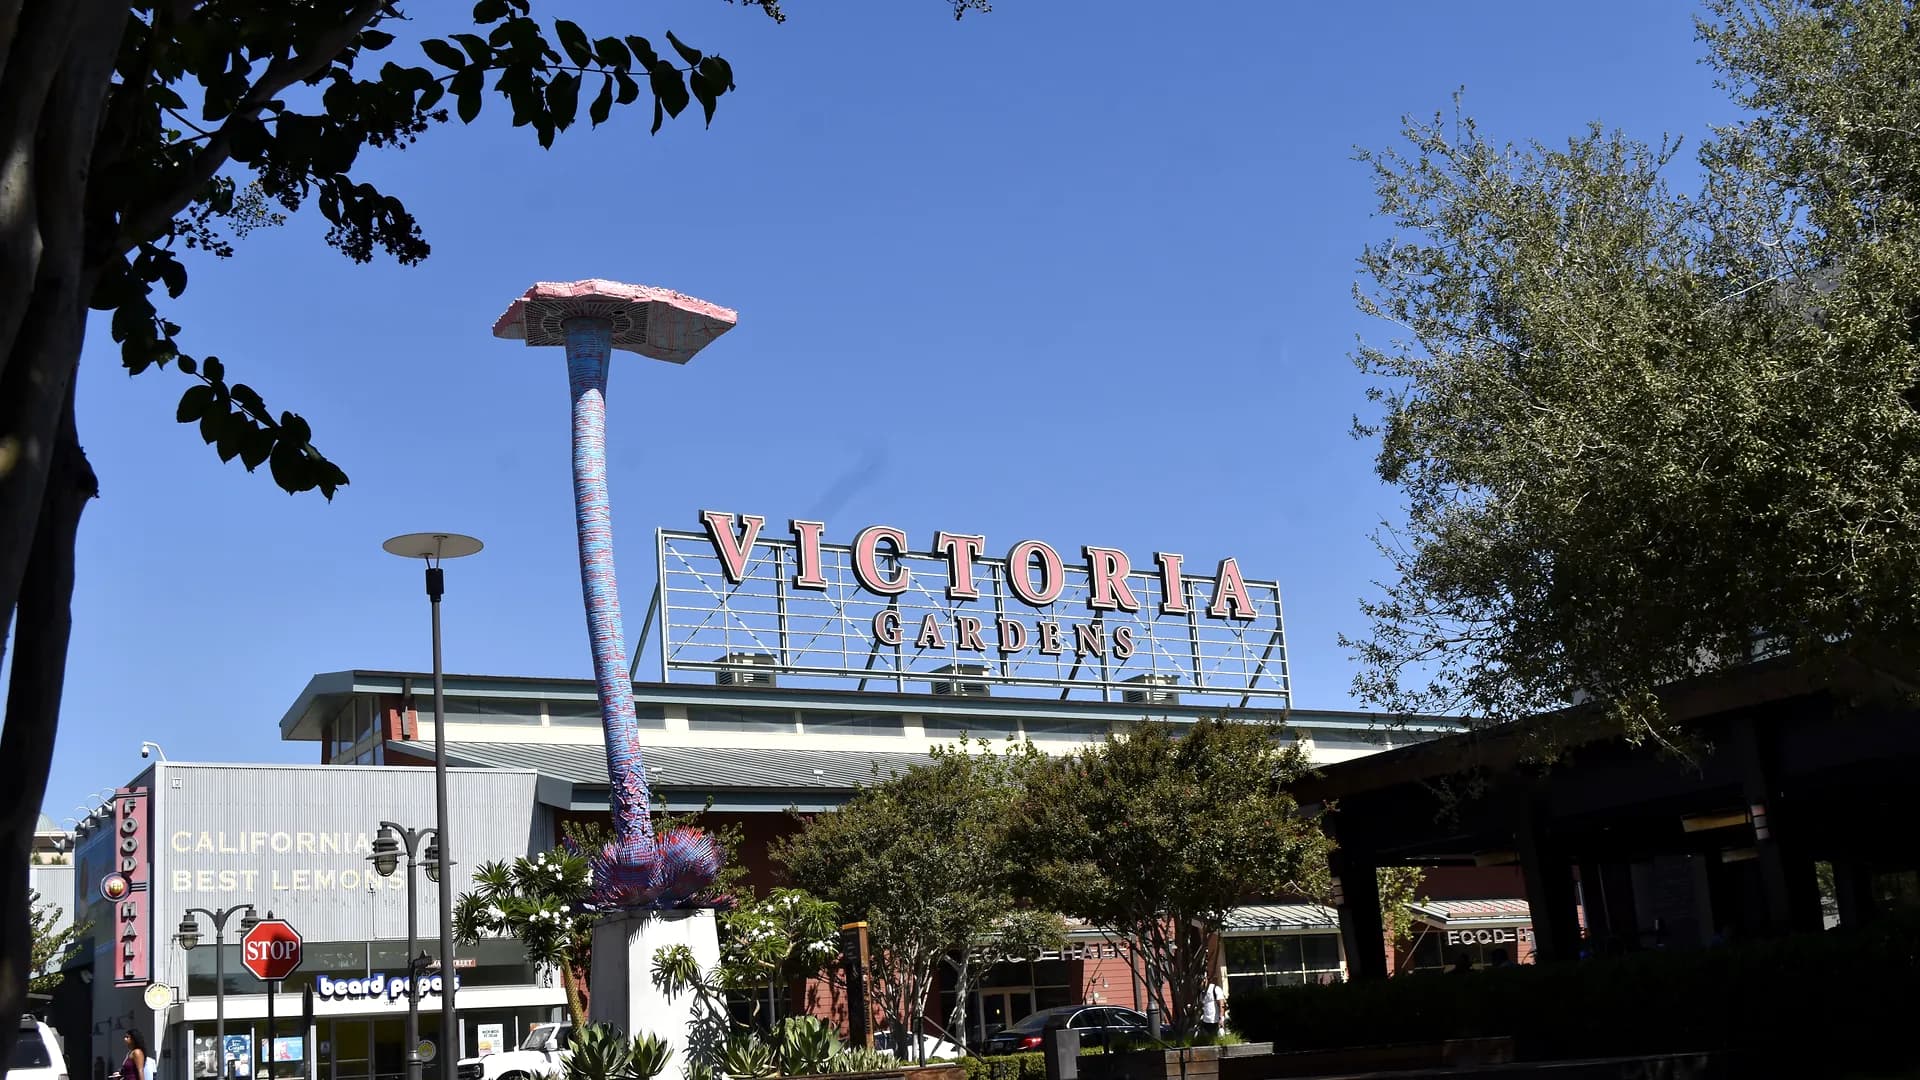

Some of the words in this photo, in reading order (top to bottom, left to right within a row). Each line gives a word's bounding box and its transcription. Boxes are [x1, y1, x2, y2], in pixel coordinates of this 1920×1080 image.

[698, 509, 1258, 620] VICTORIA
[873, 609, 1134, 660] GARDENS
[121, 798, 138, 874] FOOD
[171, 831, 372, 853] CALIFORNIA
[172, 869, 259, 892] BEST
[272, 868, 405, 891] LEMONS
[121, 902, 138, 978] HALL
[1447, 929, 1506, 945] FOOD
[247, 940, 297, 961] STOP
[317, 973, 385, 997] beard
